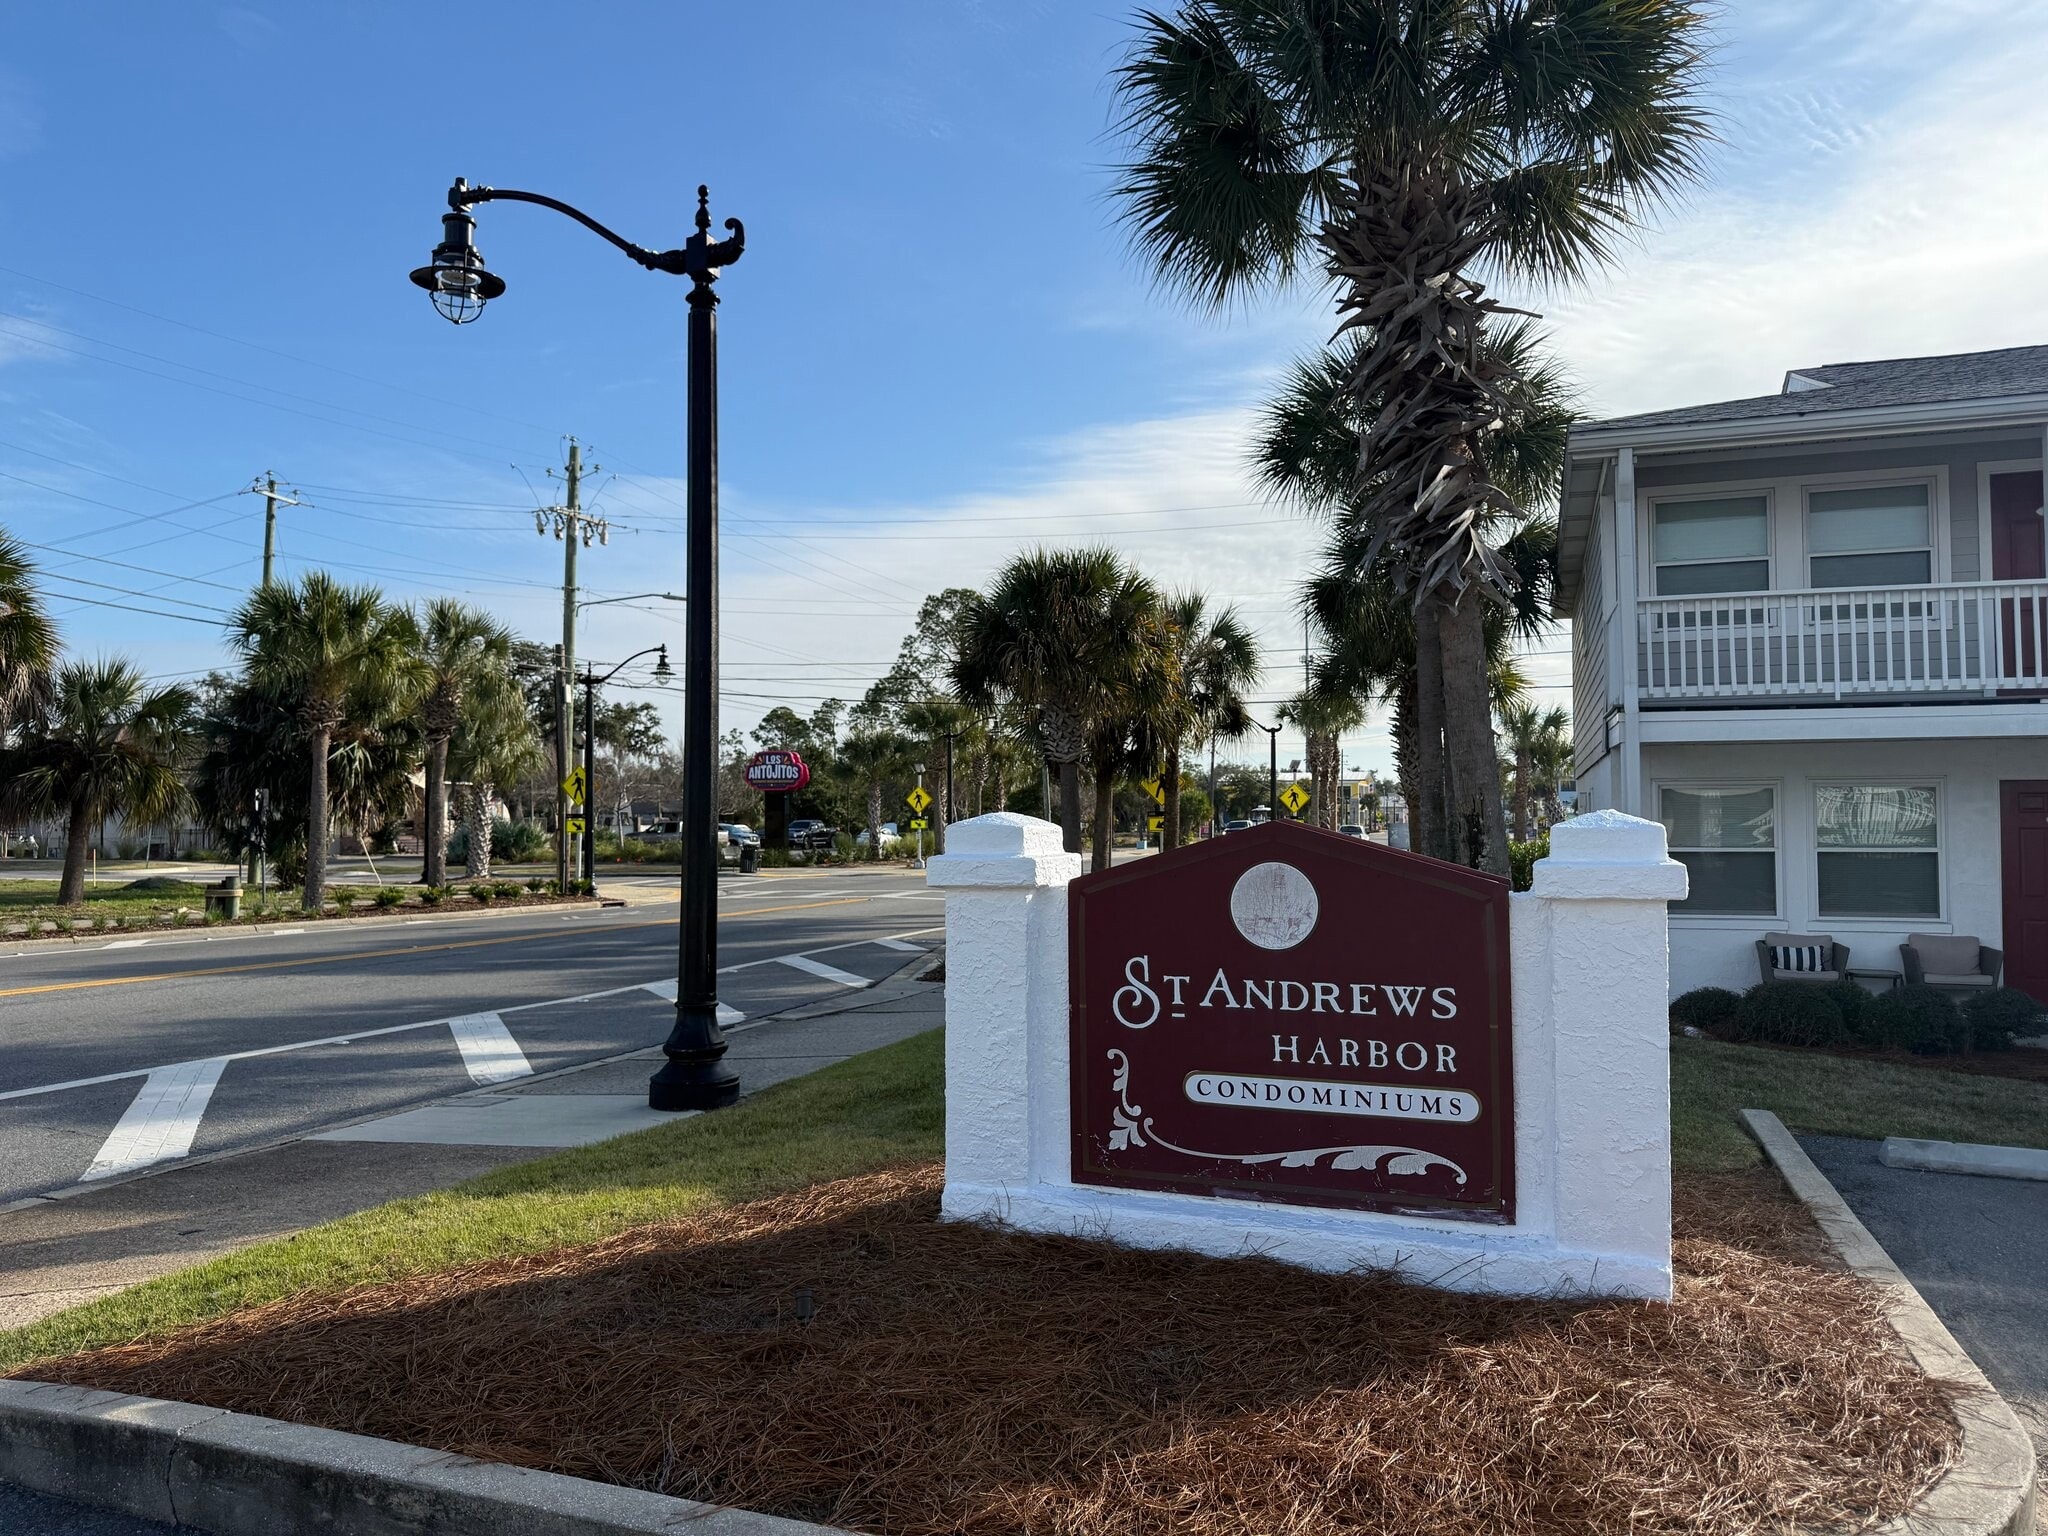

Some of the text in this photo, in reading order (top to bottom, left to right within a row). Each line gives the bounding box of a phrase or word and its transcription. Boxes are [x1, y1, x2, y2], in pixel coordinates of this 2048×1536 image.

[748, 764, 798, 779] ANTOJITOS
[765, 755, 781, 764] LOS
[1271, 1034, 1457, 1073] HARBOR
[1196, 1078, 1462, 1116] CONDOMINIUMS
